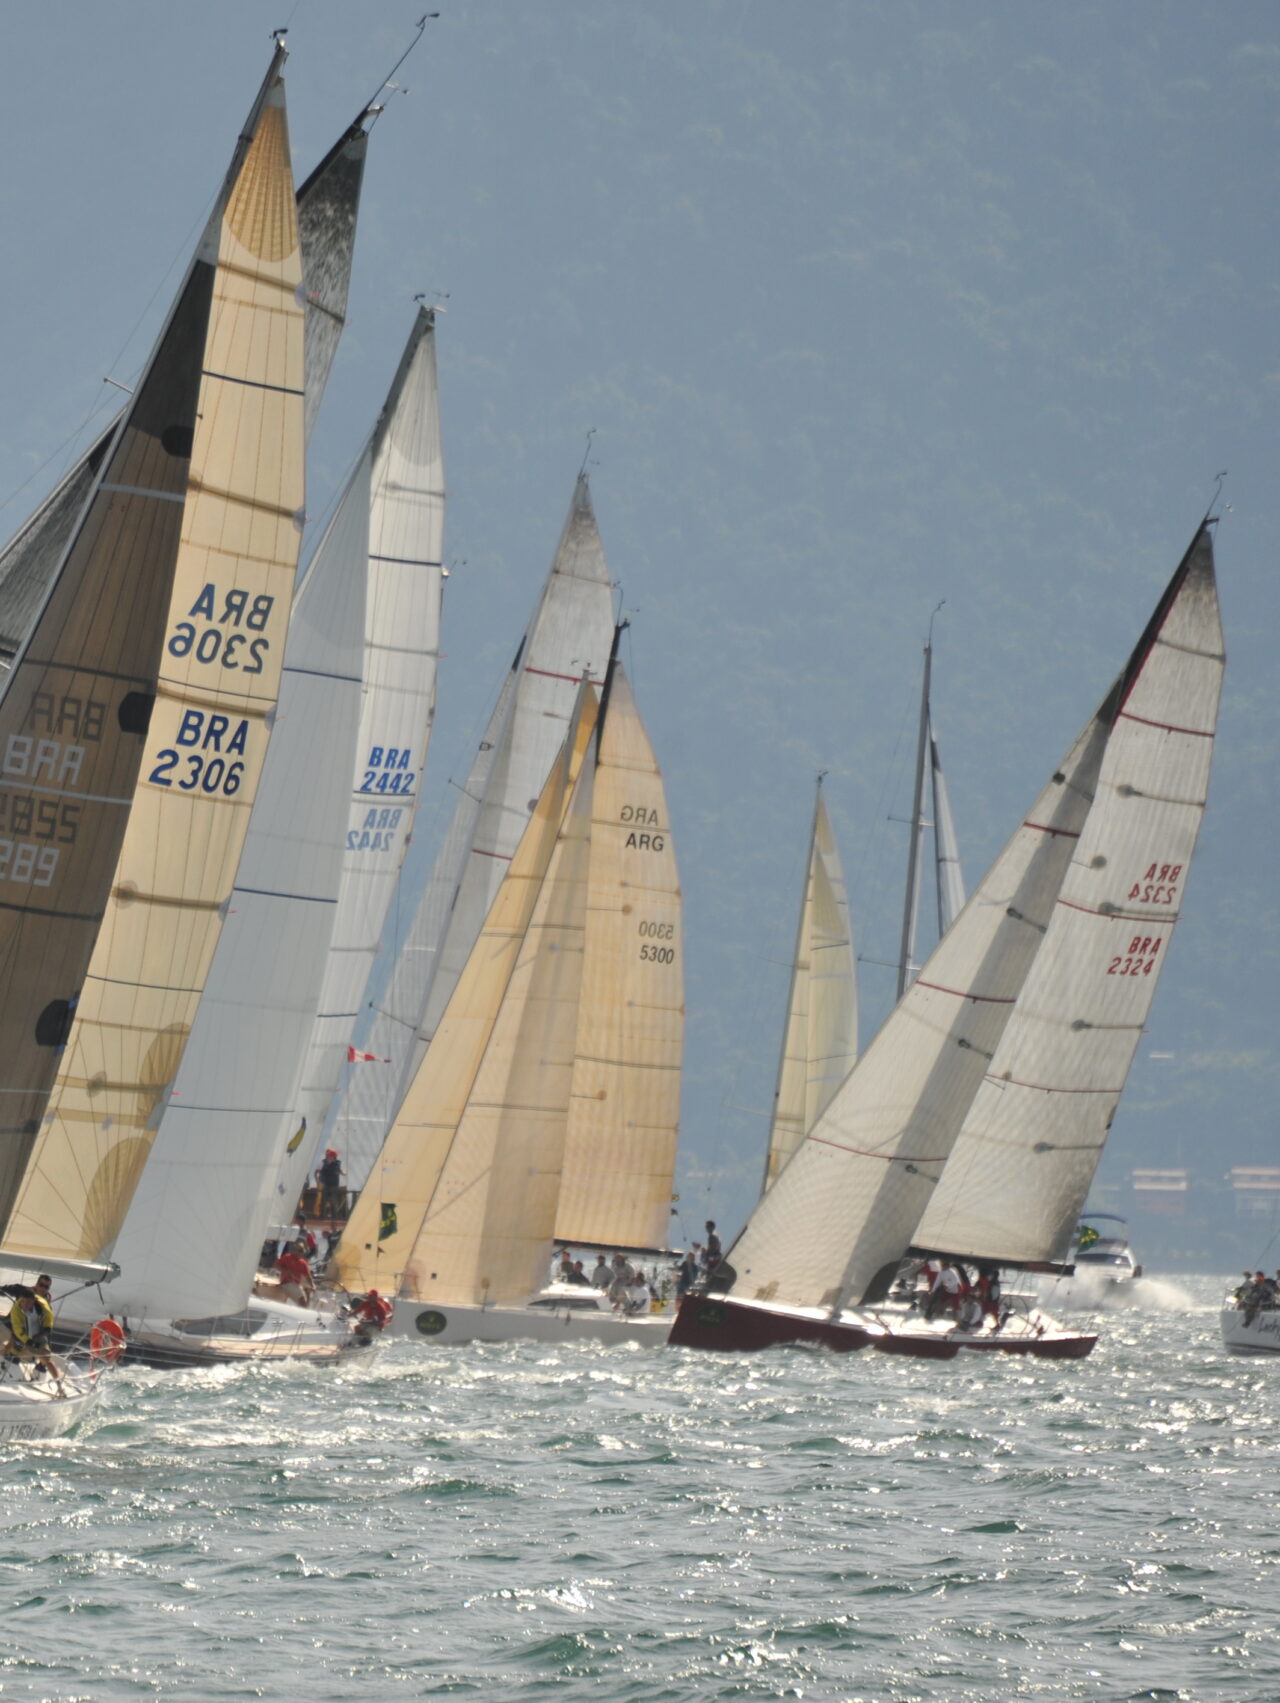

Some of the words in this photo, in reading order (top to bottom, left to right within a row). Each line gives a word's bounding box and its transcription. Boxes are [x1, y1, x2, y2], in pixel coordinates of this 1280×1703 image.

[176, 710, 249, 756] BRA
[3, 734, 85, 785] BRA
[368, 746, 411, 770] BRA
[148, 749, 245, 796] 2306
[360, 771, 415, 793] 2442
[625, 832, 665, 852] ARG
[640, 944, 675, 965] 5300
[1128, 936, 1162, 956] BRA
[1107, 956, 1155, 976] 2324
